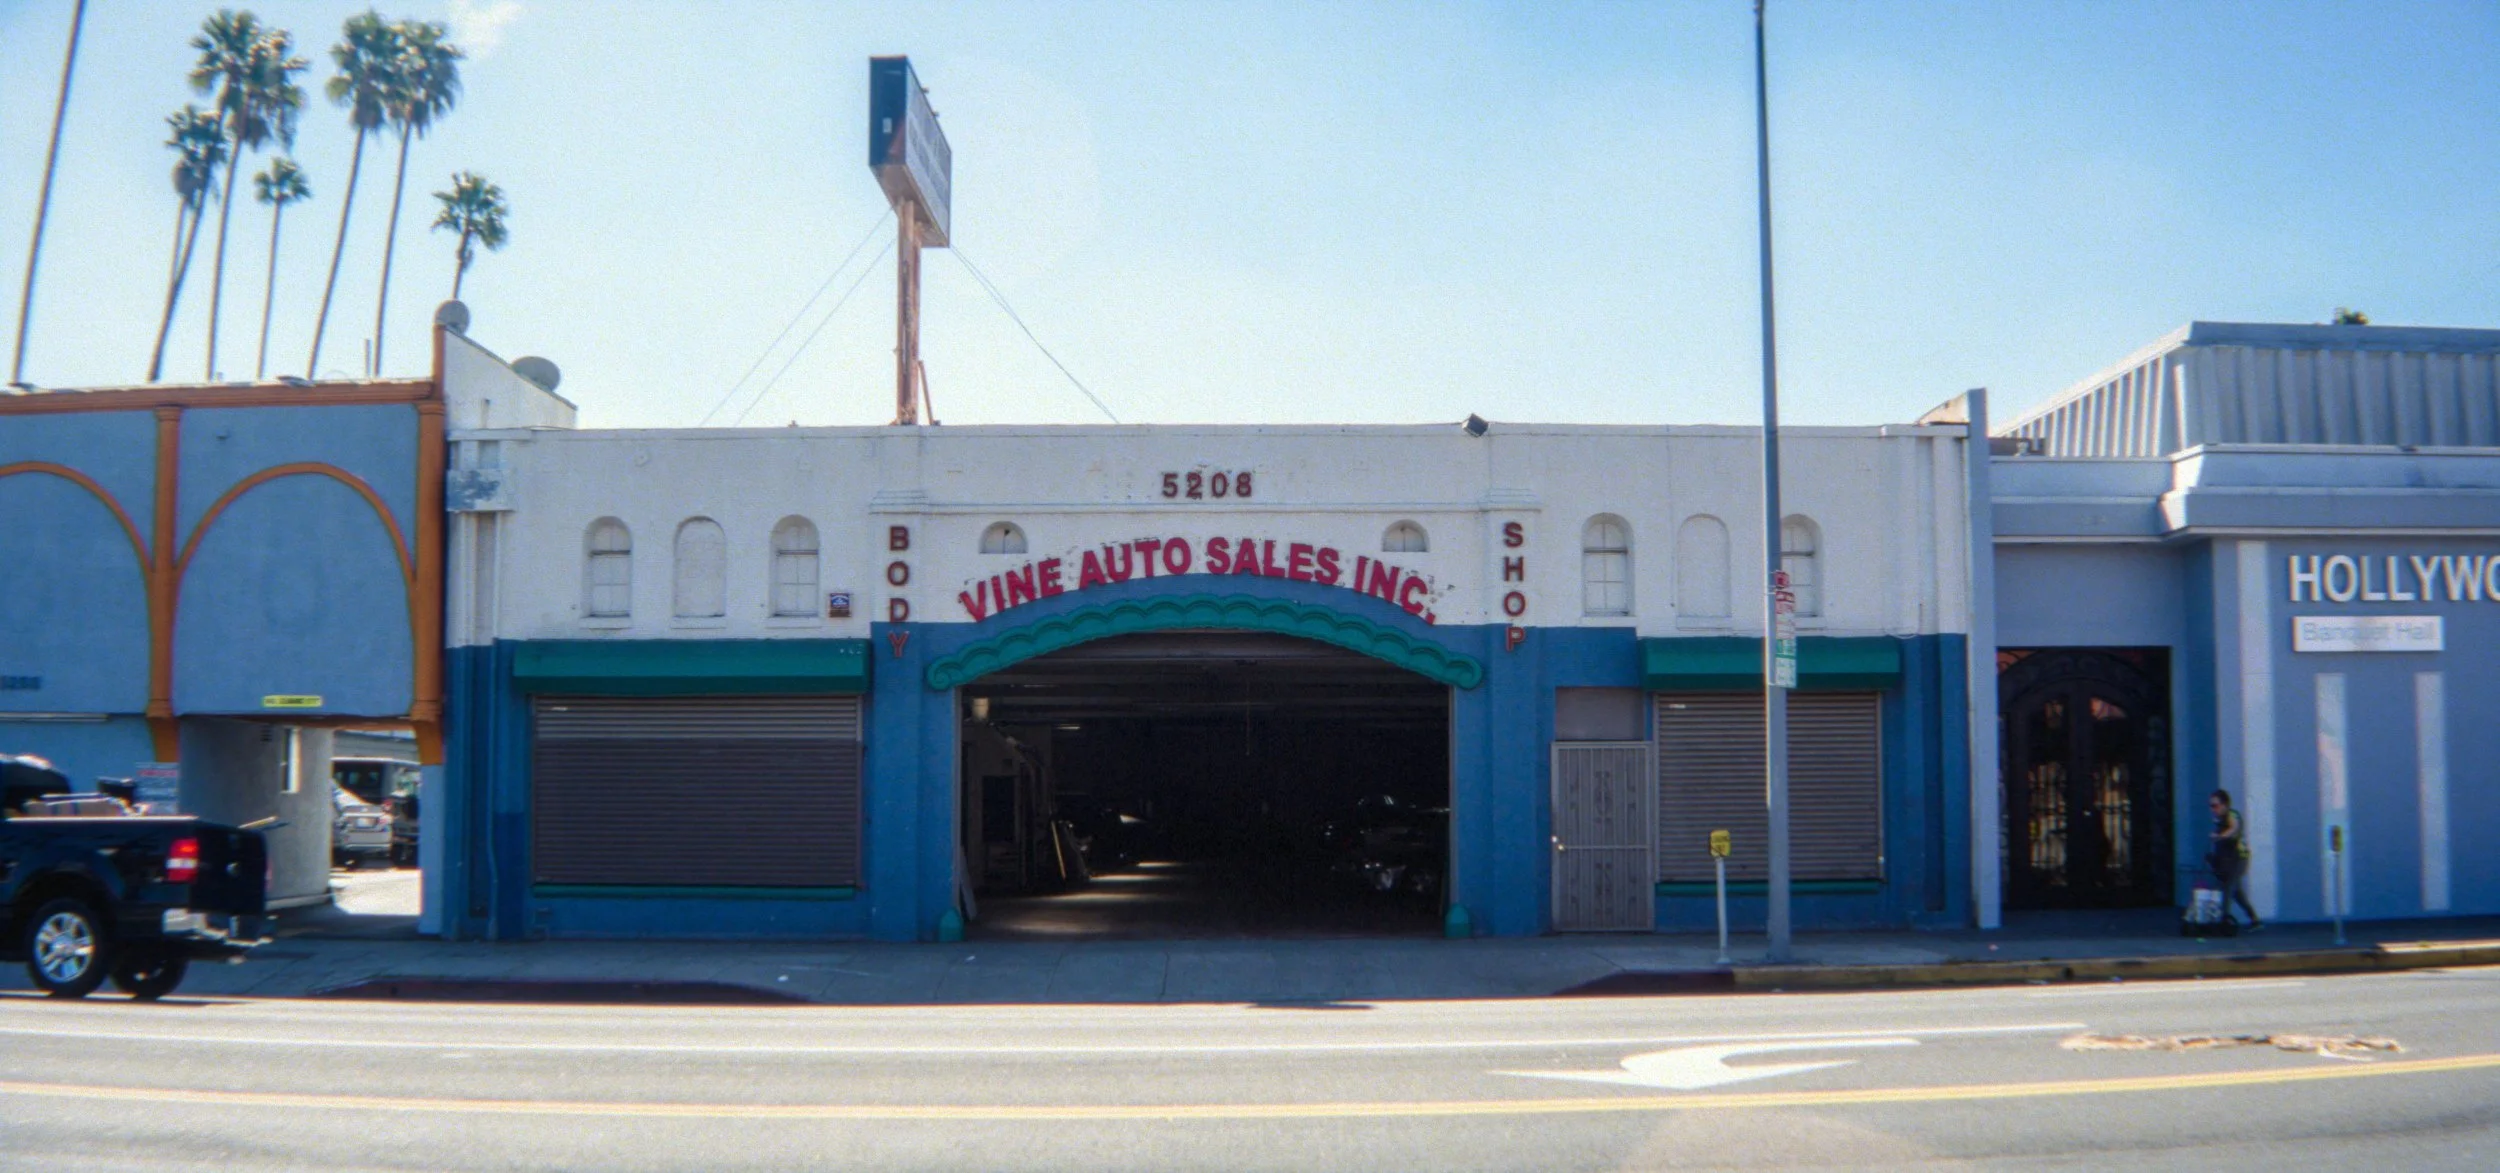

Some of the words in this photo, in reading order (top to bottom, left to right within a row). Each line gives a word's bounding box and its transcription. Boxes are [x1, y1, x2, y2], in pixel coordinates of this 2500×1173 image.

[1161, 471, 1252, 499] 5208
[887, 525, 910, 657] BODY
[958, 557, 1064, 623] VINE
[1079, 537, 1191, 590] AUTO
[1206, 536, 1340, 586] SALES
[1354, 555, 1436, 626] INC.
[1503, 522, 1526, 652] SHOP
